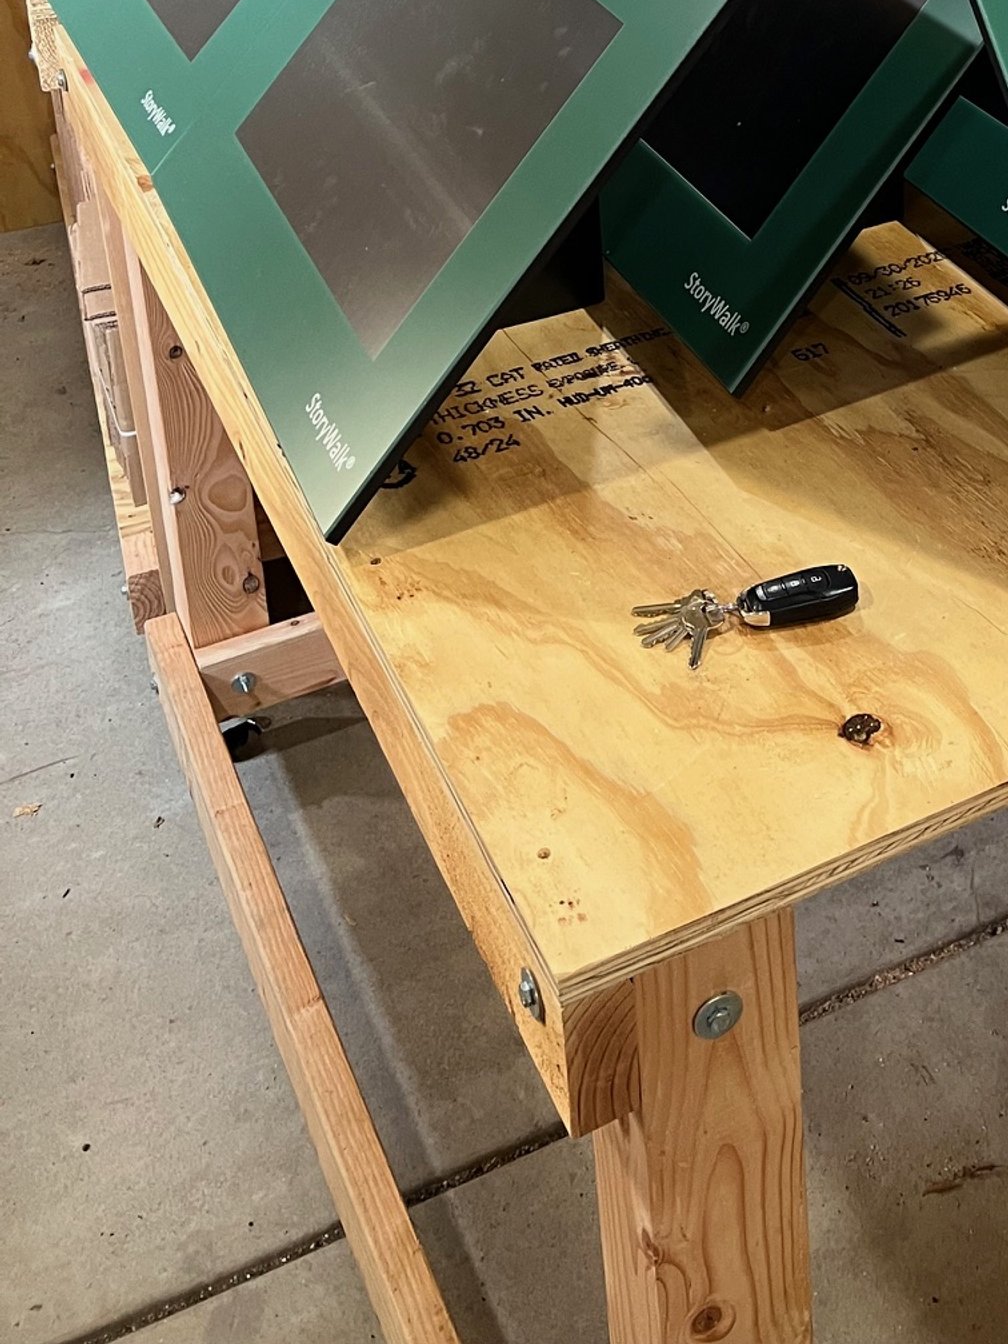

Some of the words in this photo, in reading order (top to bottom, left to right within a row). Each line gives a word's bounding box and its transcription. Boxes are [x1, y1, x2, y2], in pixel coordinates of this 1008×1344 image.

[864, 277, 921, 299] 21:26
[486, 366, 525, 387] CAT
[436, 416, 505, 444] 0.703
[512, 405, 554, 423] IN.
[453, 433, 521, 462] 48/24
